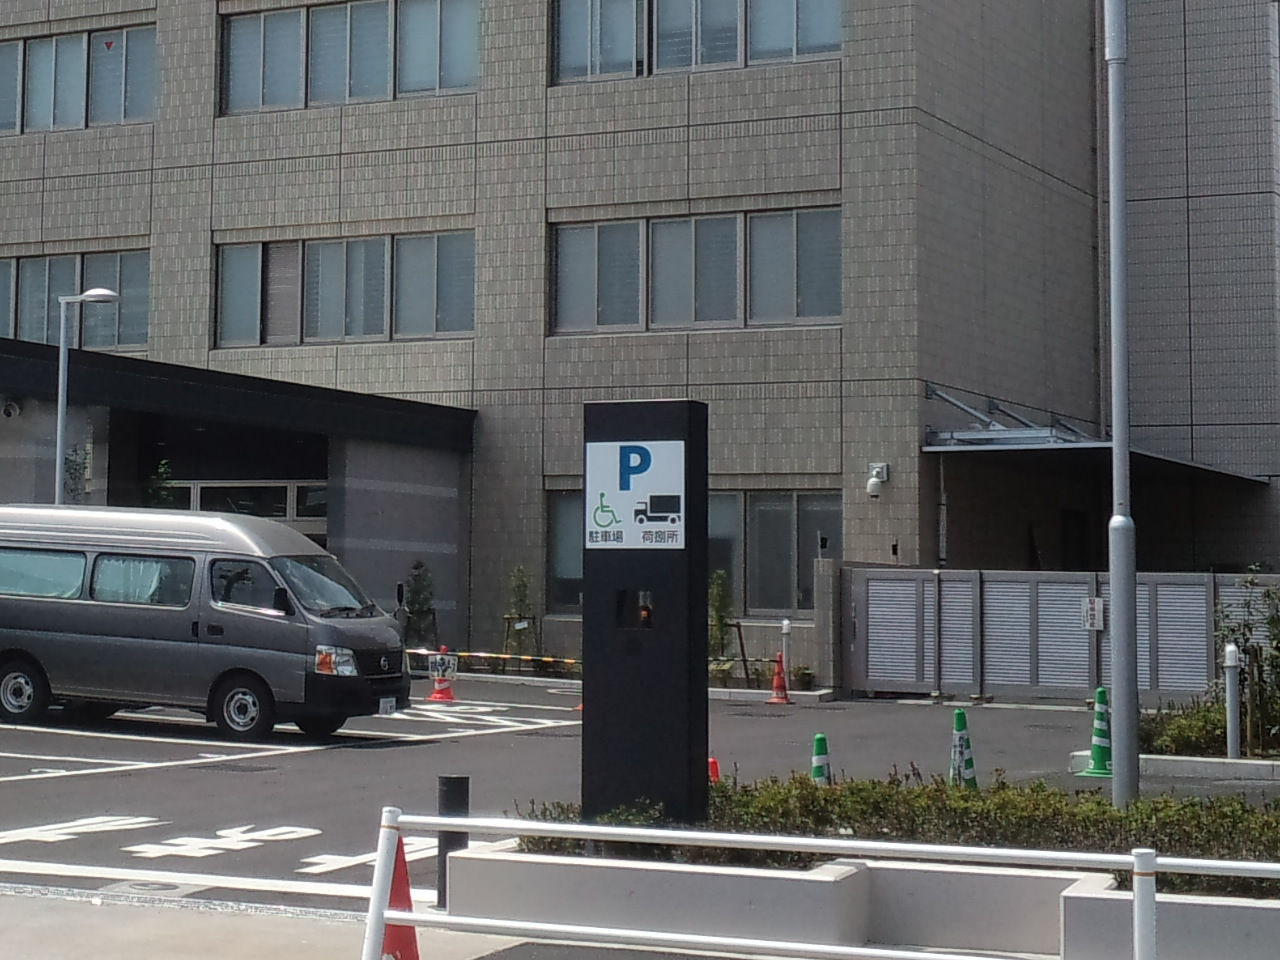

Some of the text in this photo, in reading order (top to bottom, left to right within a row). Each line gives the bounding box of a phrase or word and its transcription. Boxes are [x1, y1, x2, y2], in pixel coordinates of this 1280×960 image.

[619, 445, 651, 491] P
[588, 530, 624, 543] 駐車場
